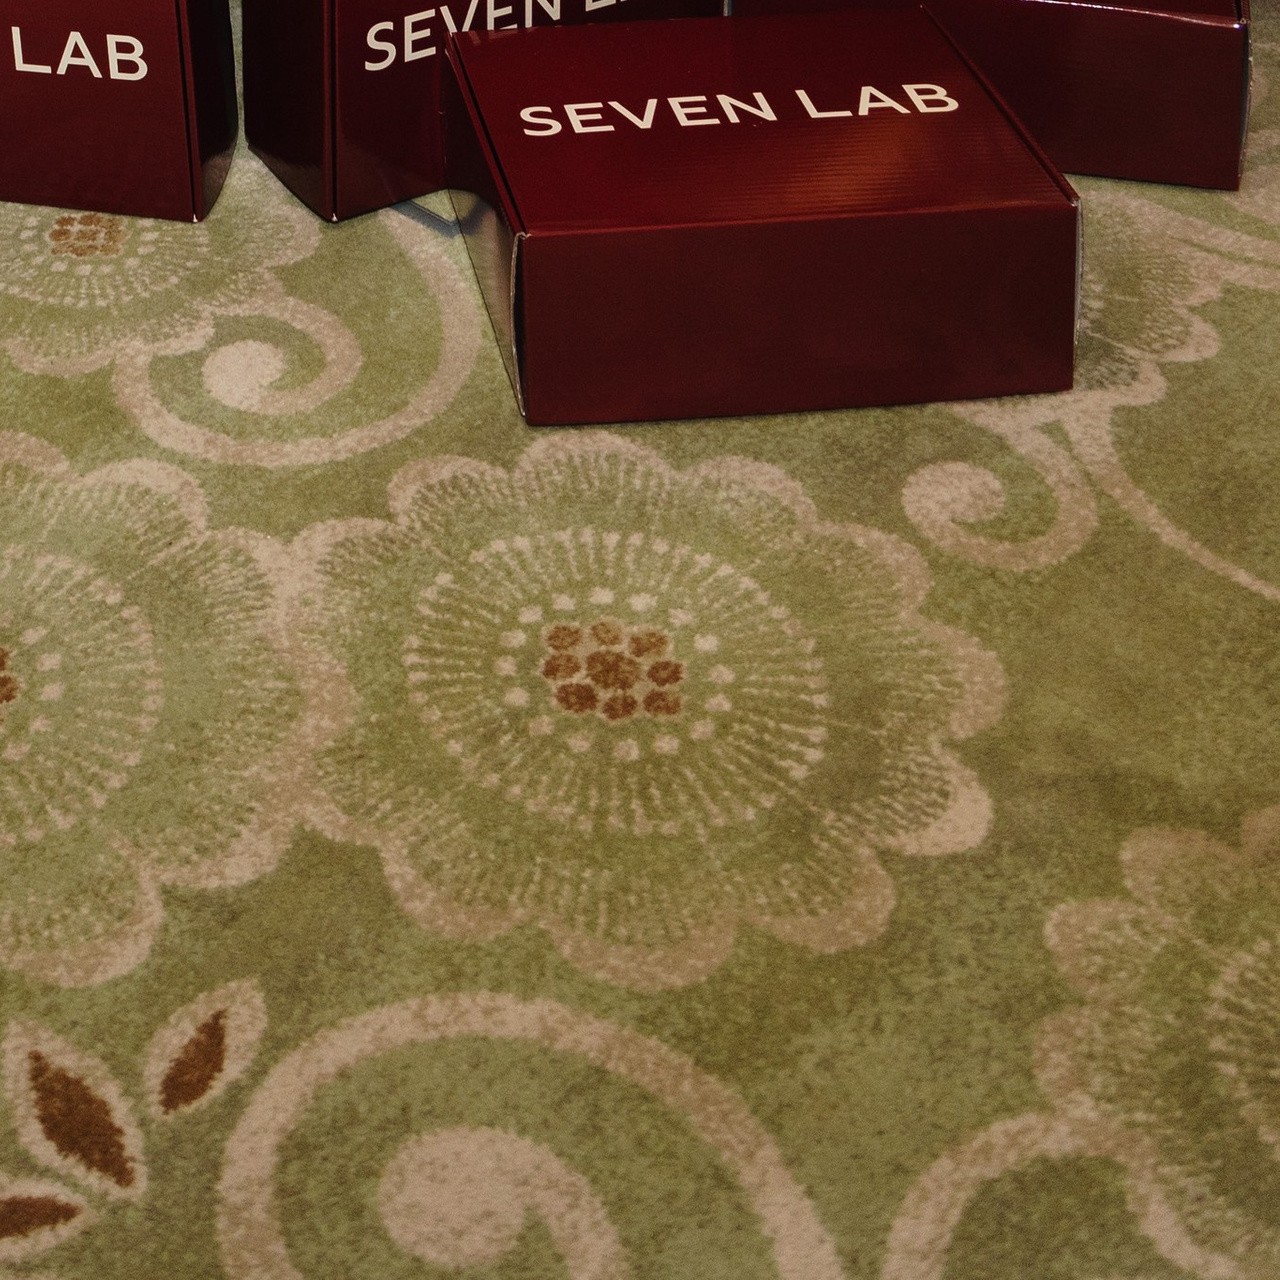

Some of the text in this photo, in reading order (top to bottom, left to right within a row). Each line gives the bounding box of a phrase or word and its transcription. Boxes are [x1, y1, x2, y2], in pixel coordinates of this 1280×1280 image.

[11, 26, 148, 81] LAB
[519, 84, 959, 136] SEVEN LAB
